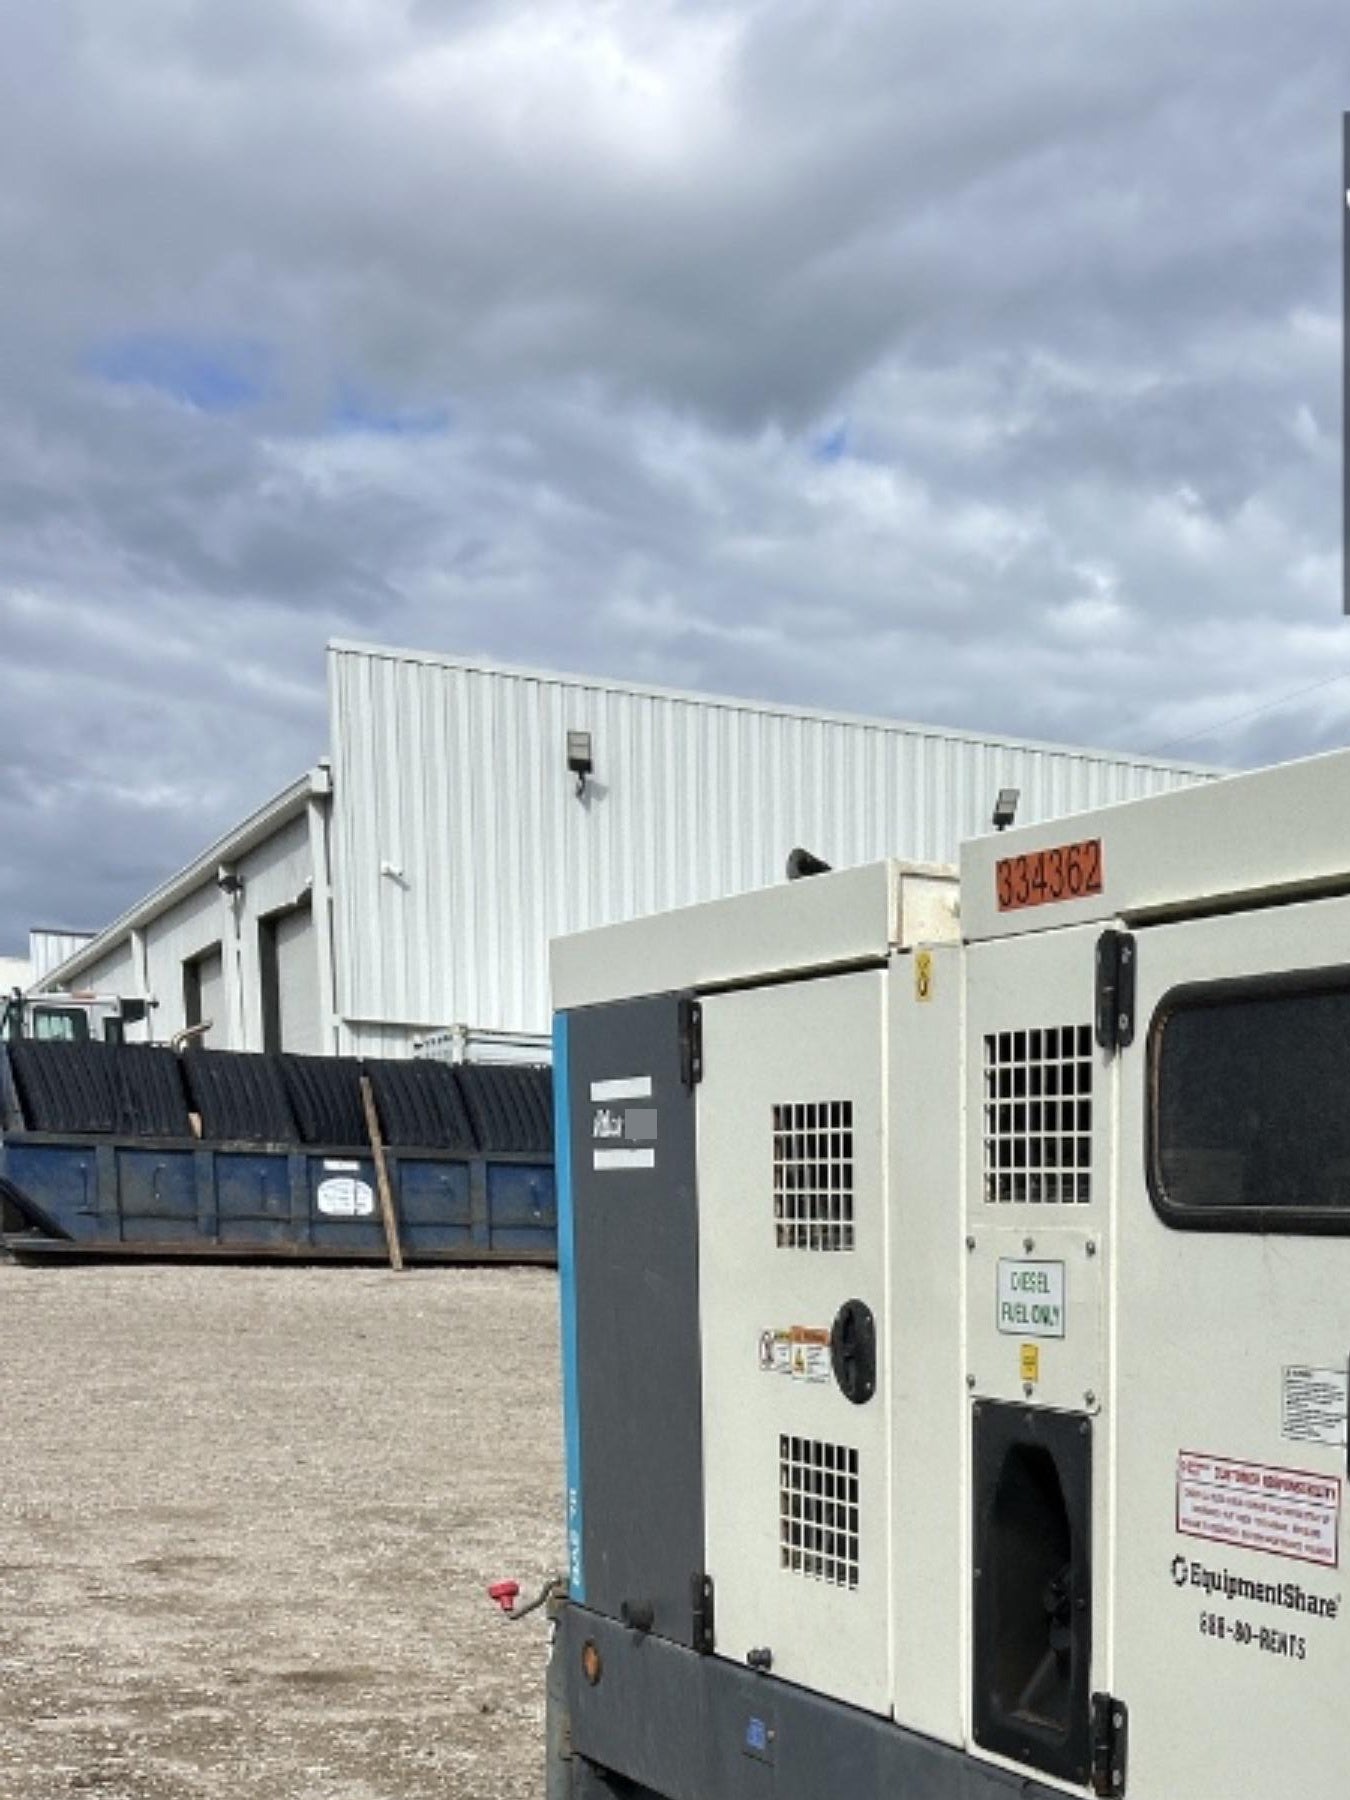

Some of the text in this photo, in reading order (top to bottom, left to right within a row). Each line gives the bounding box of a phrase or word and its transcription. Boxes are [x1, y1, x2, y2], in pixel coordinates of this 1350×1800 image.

[998, 840, 1101, 906] 334362
[1010, 1271, 1051, 1294] DIESEL
[1002, 1301, 1060, 1327] FUEL ONLY
[1190, 1562, 1338, 1618] EquipmentShare
